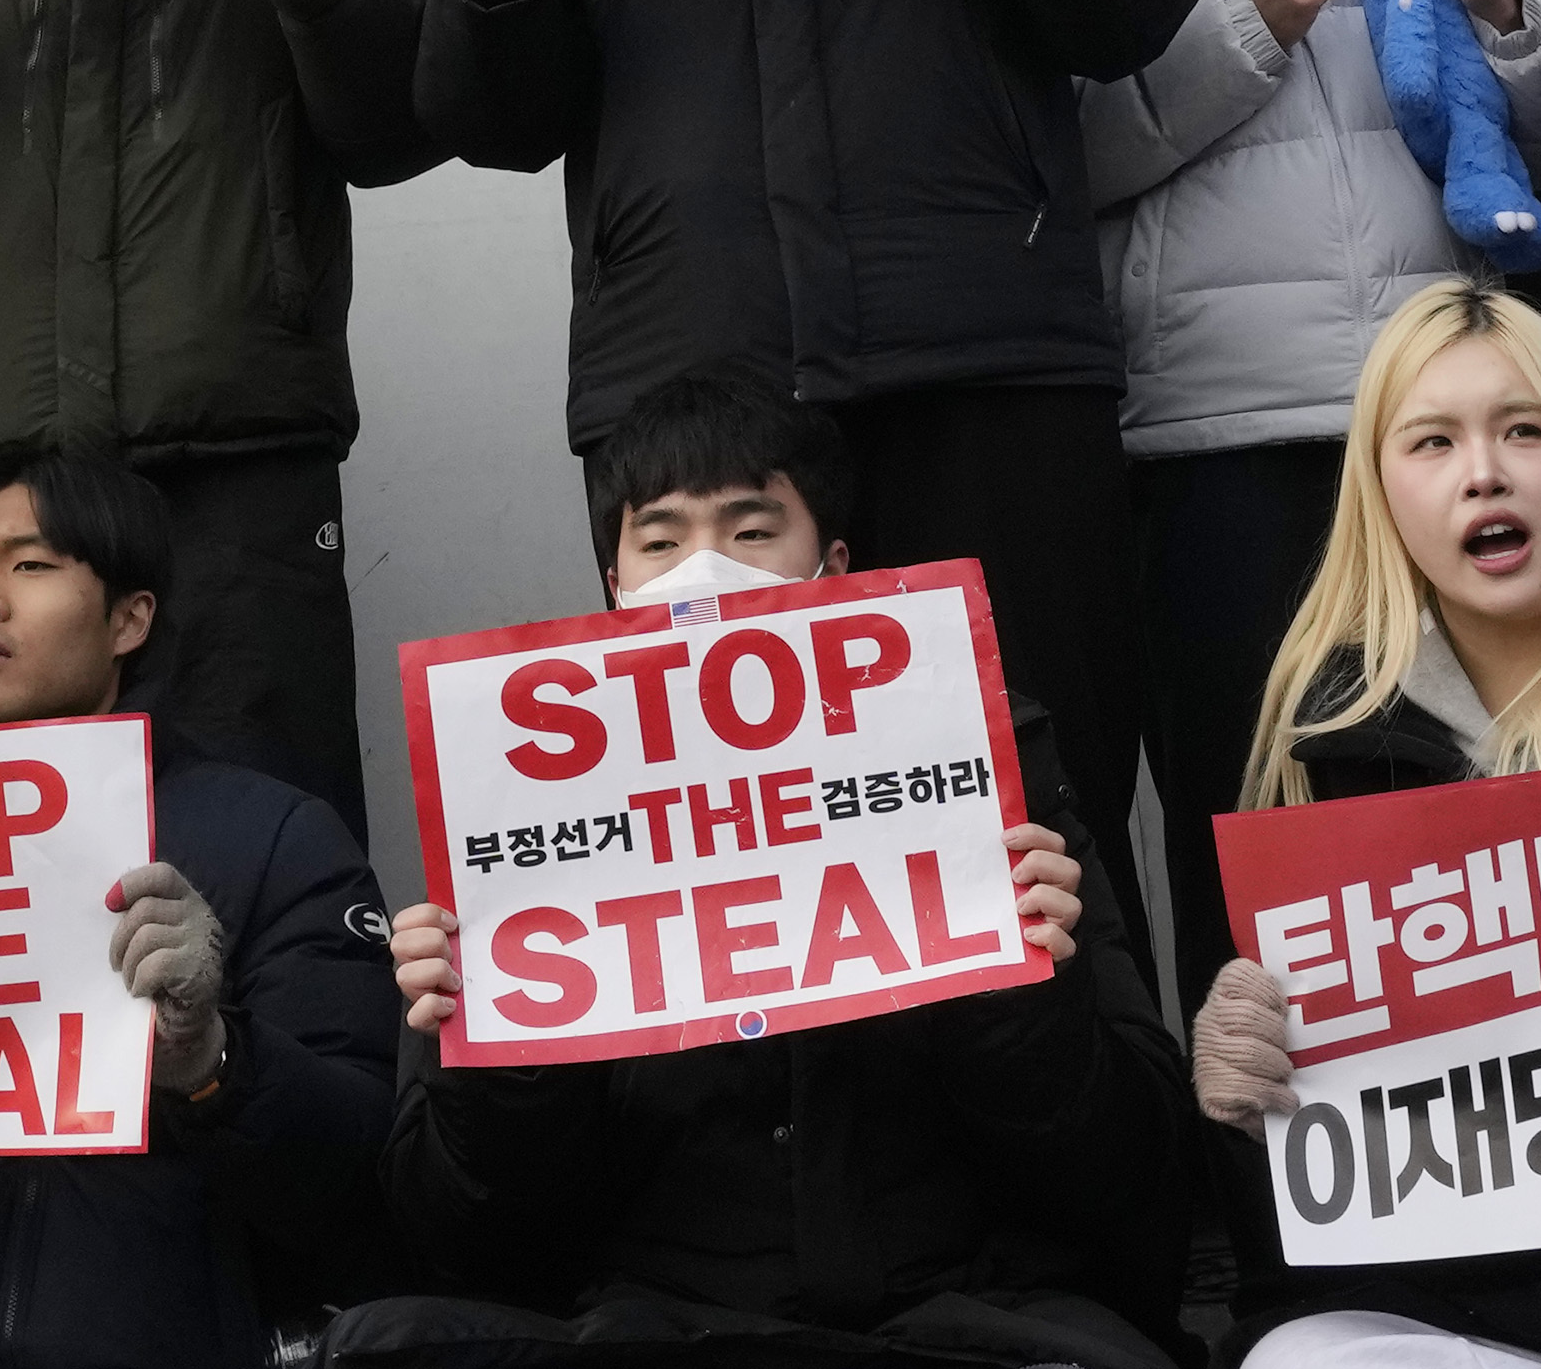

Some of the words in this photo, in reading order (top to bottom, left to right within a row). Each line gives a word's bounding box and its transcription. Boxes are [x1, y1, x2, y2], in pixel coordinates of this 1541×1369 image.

[500, 611, 912, 782] STOP
[464, 812, 635, 875] 부정선거
[627, 767, 824, 865] THE
[820, 757, 991, 822] 검증하라
[490, 849, 1002, 1029] STEAL
